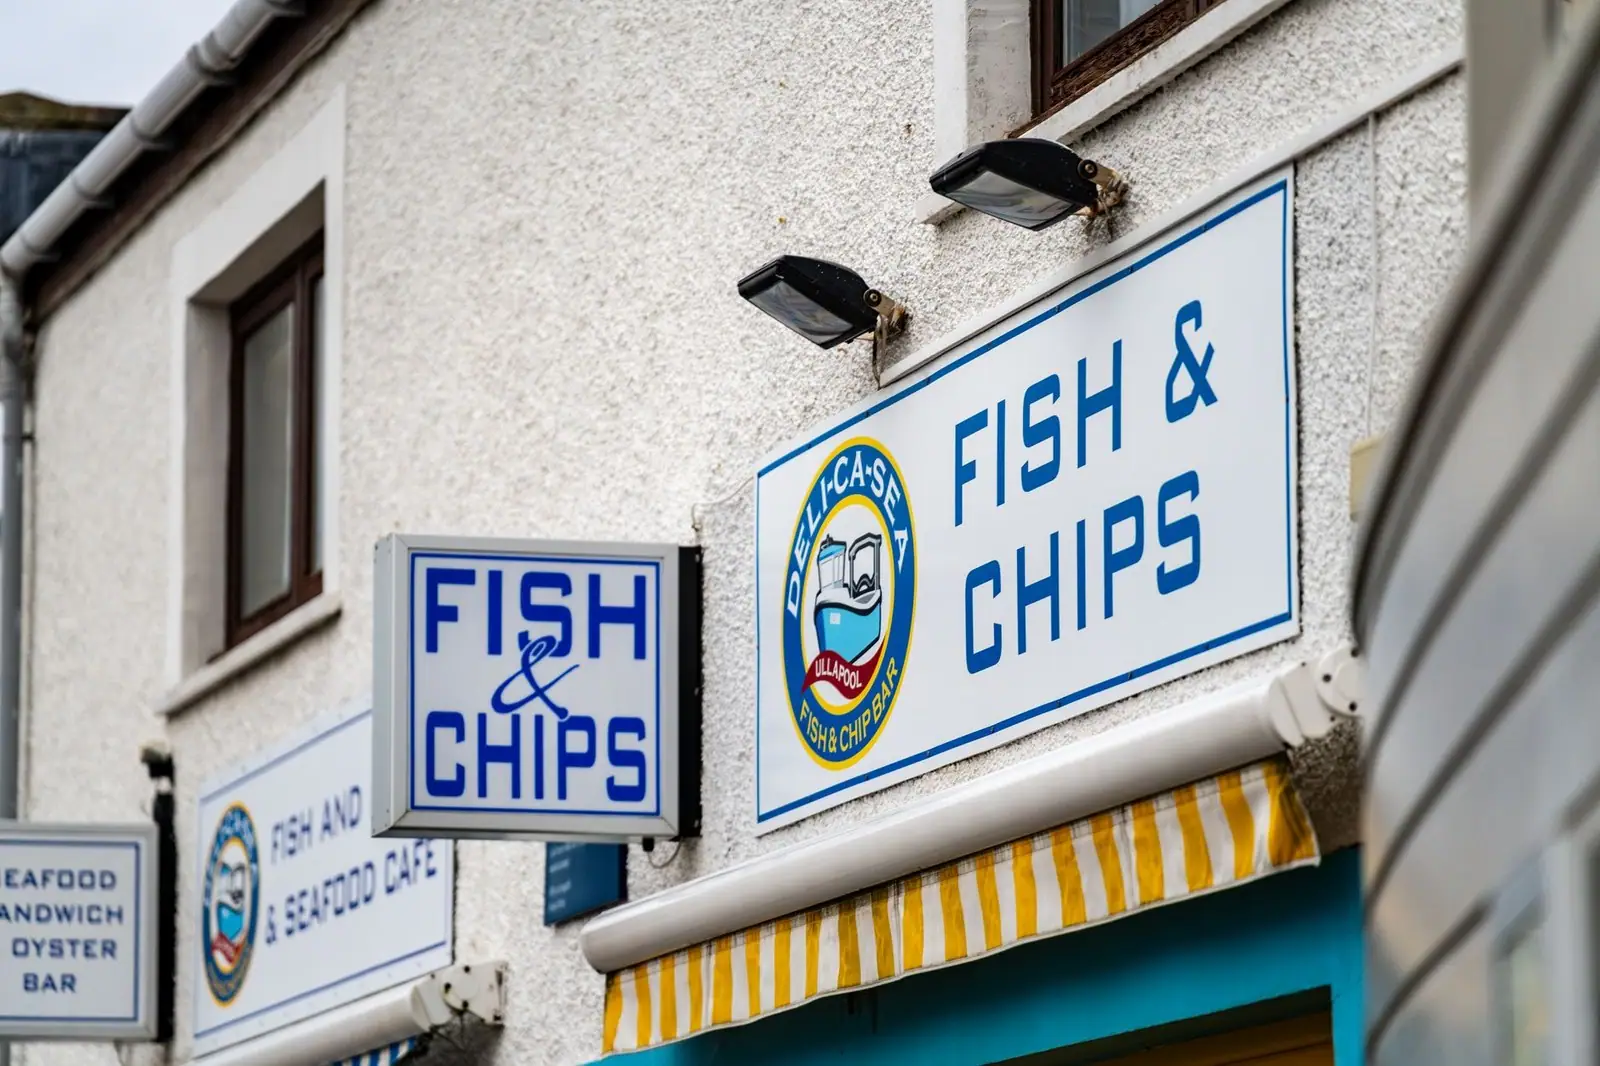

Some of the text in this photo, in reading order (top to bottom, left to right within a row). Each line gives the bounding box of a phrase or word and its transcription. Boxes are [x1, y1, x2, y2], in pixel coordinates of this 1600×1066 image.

[954, 300, 1218, 527] FISH &
[425, 567, 646, 660] FISH
[965, 470, 1202, 676] CHIPS
[491, 635, 580, 721] &
[800, 657, 898, 753] FISH & CHIP BAR
[815, 657, 863, 690] ULLAPOOL
[425, 711, 647, 802] CHIPS
[271, 807, 313, 866] FISH
[320, 785, 363, 842] AND
[0, 868, 117, 890] EAFOOD
[0, 902, 123, 924] ANDWICH
[265, 904, 277, 945] &
[285, 860, 376, 936] SEAFOOD
[12, 937, 117, 960] OYSTER
[23, 972, 77, 993] BAR
